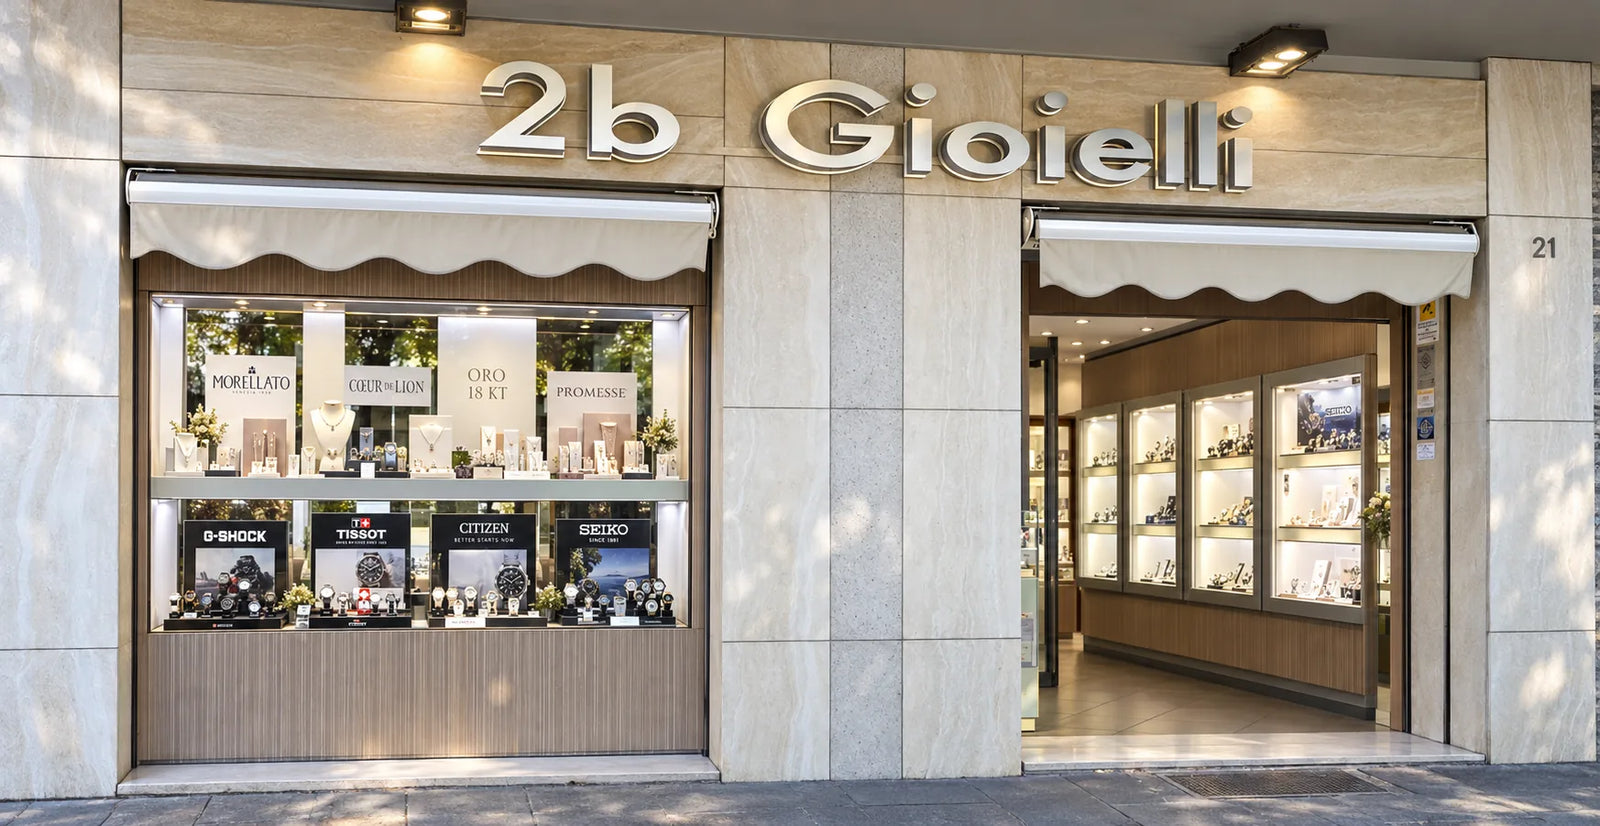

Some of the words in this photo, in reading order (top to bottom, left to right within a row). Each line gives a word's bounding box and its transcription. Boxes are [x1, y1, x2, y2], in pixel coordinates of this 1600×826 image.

[476, 60, 681, 164] 2b
[758, 79, 1254, 193] Gioielli
[1532, 236, 1556, 259] 21
[467, 368, 506, 383] ORO
[212, 375, 291, 391] MORELLATO
[384, 382, 394, 391] DE
[395, 380, 425, 394] LION
[468, 386, 484, 400] 18
[488, 386, 508, 400] KT
[556, 386, 628, 399] PROMESSE
[1325, 405, 1353, 416] SEIKO
[335, 529, 387, 540] TISSOT
[459, 522, 510, 534] CITIZEN
[579, 523, 629, 536] SEIKO
[203, 530, 267, 542] G-SHOCK
